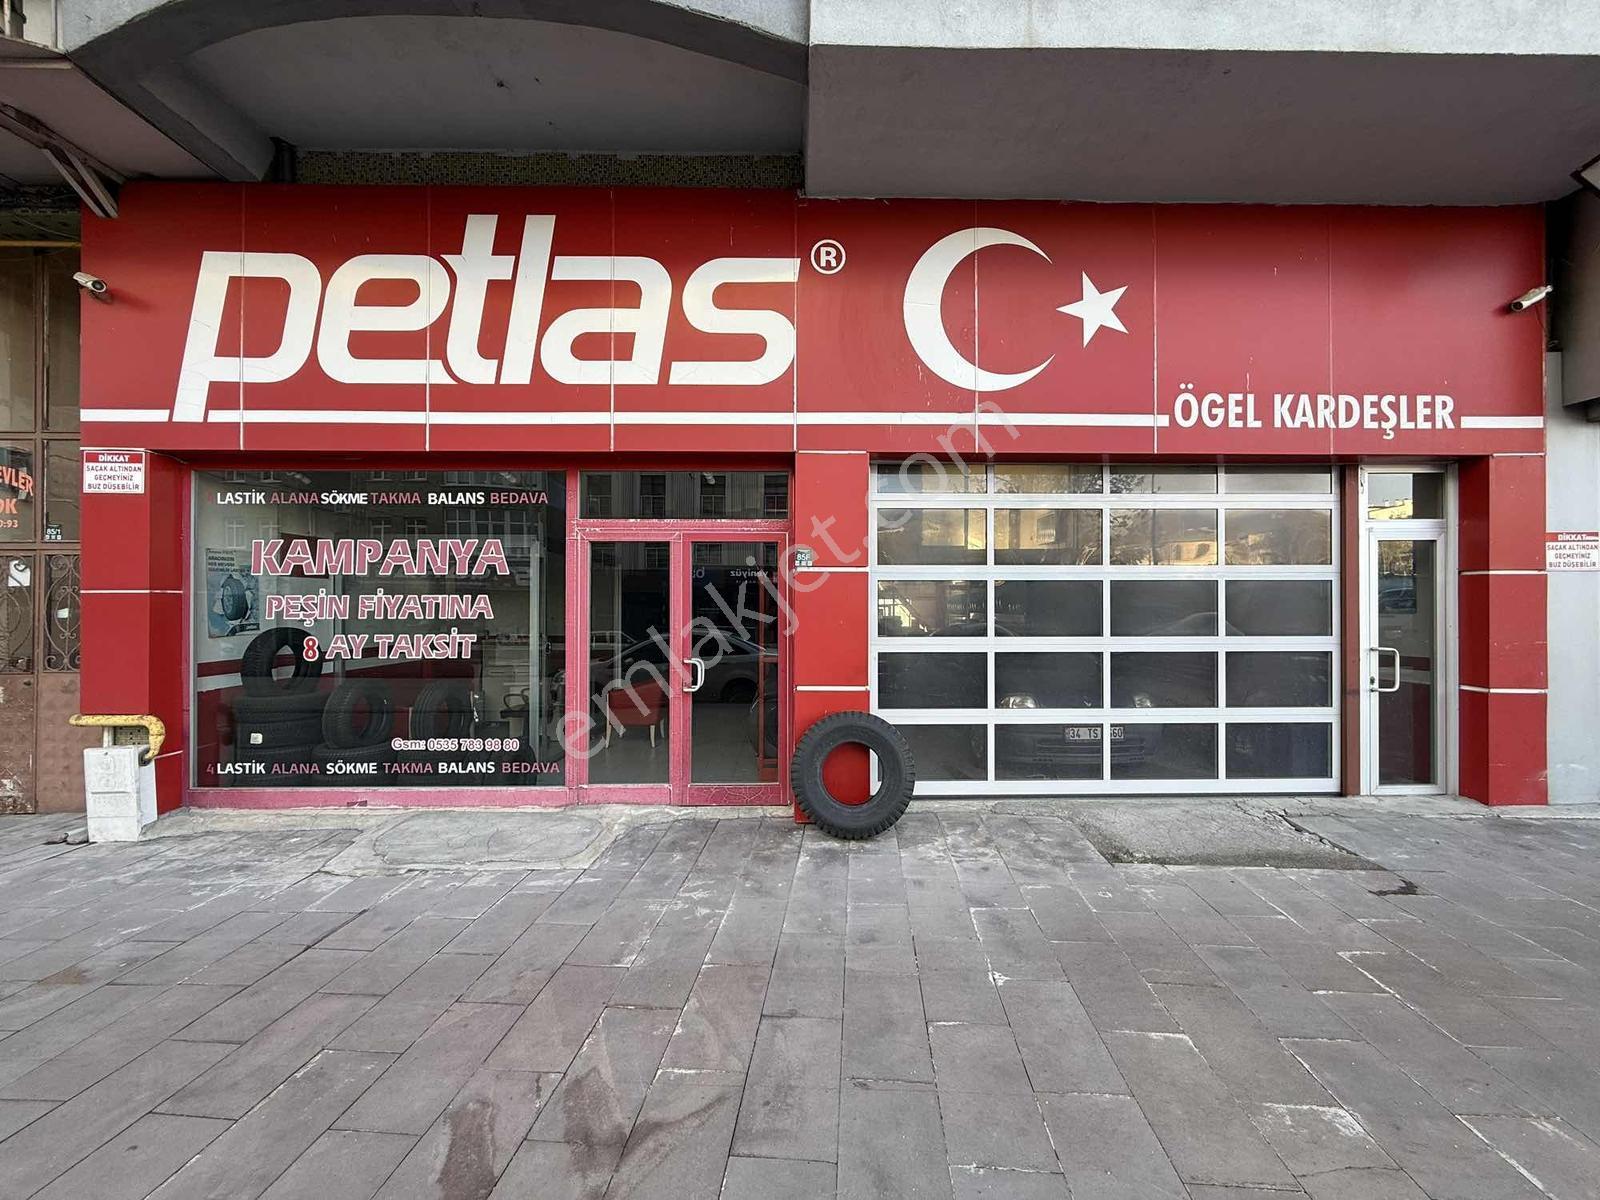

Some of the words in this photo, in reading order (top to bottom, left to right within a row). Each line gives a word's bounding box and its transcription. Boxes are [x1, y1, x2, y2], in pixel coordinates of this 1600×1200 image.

[172, 214, 801, 422] petlas
[1174, 382, 1262, 428] ÖGEL
[1273, 393, 1456, 440] KARDEŞLER
[98, 453, 130, 462] DİKKAT
[94, 473, 134, 481] GEÇMEYİNİZ
[103, 482, 140, 490] DÜŞEBİLİR
[217, 489, 266, 505] LASTİK
[270, 492, 319, 504] ALANA
[320, 490, 369, 505] SÖKME
[370, 492, 421, 504] TAKMA
[428, 492, 485, 505] BALANS
[490, 492, 548, 504] BEDAVA
[1558, 533, 1587, 541] DİKKAT
[251, 539, 510, 576] KAMPANYA
[265, 588, 350, 627] PEŞİN
[358, 588, 494, 620] FİYATINA
[303, 636, 320, 661] 8
[325, 634, 369, 659] AY
[374, 627, 477, 659] TAKSİT
[391, 738, 426, 751] Gsm:
[427, 739, 458, 751] 0535
[460, 739, 483, 751] 783
[484, 739, 501, 751] 98
[502, 739, 520, 751] 80
[217, 760, 265, 774] LASTİK
[271, 763, 320, 774] ALANA
[326, 760, 377, 774] SÖKME
[383, 763, 433, 774] TAKMA
[438, 762, 495, 774] BALANS
[502, 763, 560, 774] BEDAVA
